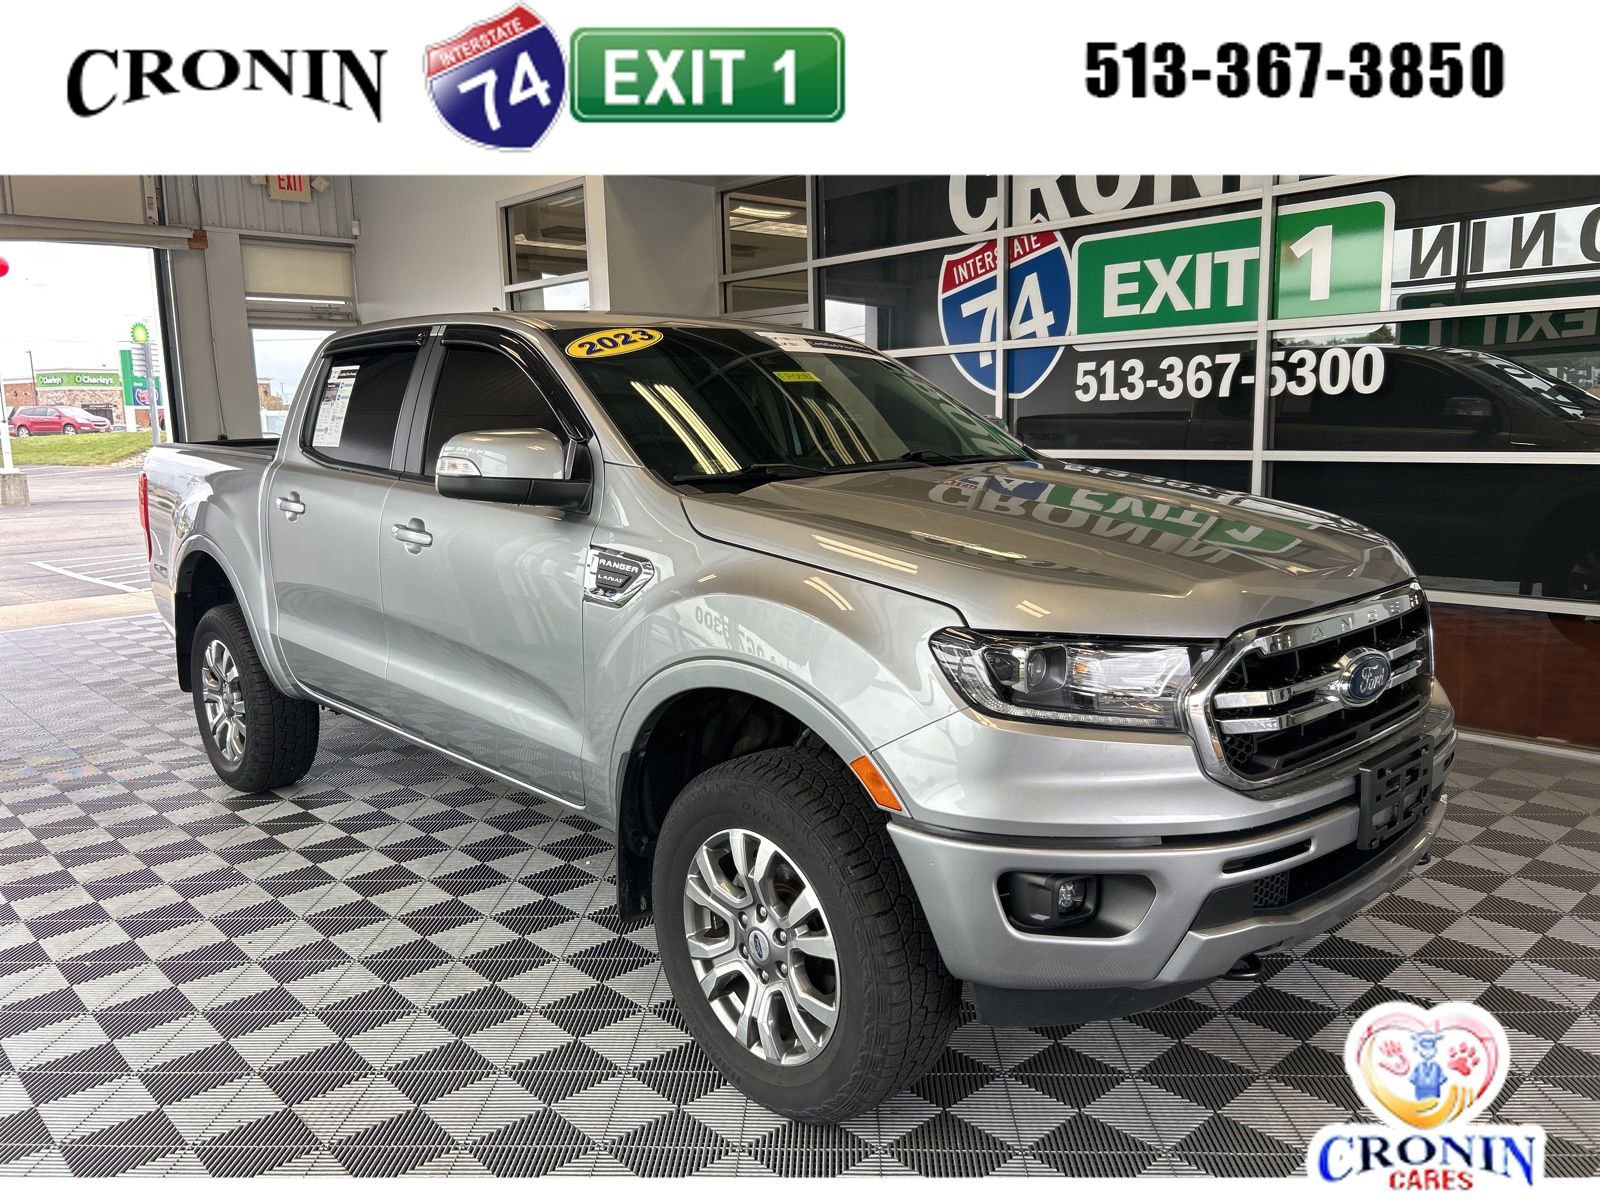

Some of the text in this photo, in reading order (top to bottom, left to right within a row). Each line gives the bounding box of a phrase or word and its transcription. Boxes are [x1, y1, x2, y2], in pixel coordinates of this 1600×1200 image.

[953, 234, 1041, 285] INTERSATE
[1103, 225, 1333, 318] EXIT 1
[578, 330, 655, 355] 2023
[960, 271, 1055, 368] 74
[1075, 346, 1385, 403] 513-367-5300
[599, 558, 639, 574] RANGER
[1359, 665, 1386, 693] Ford
